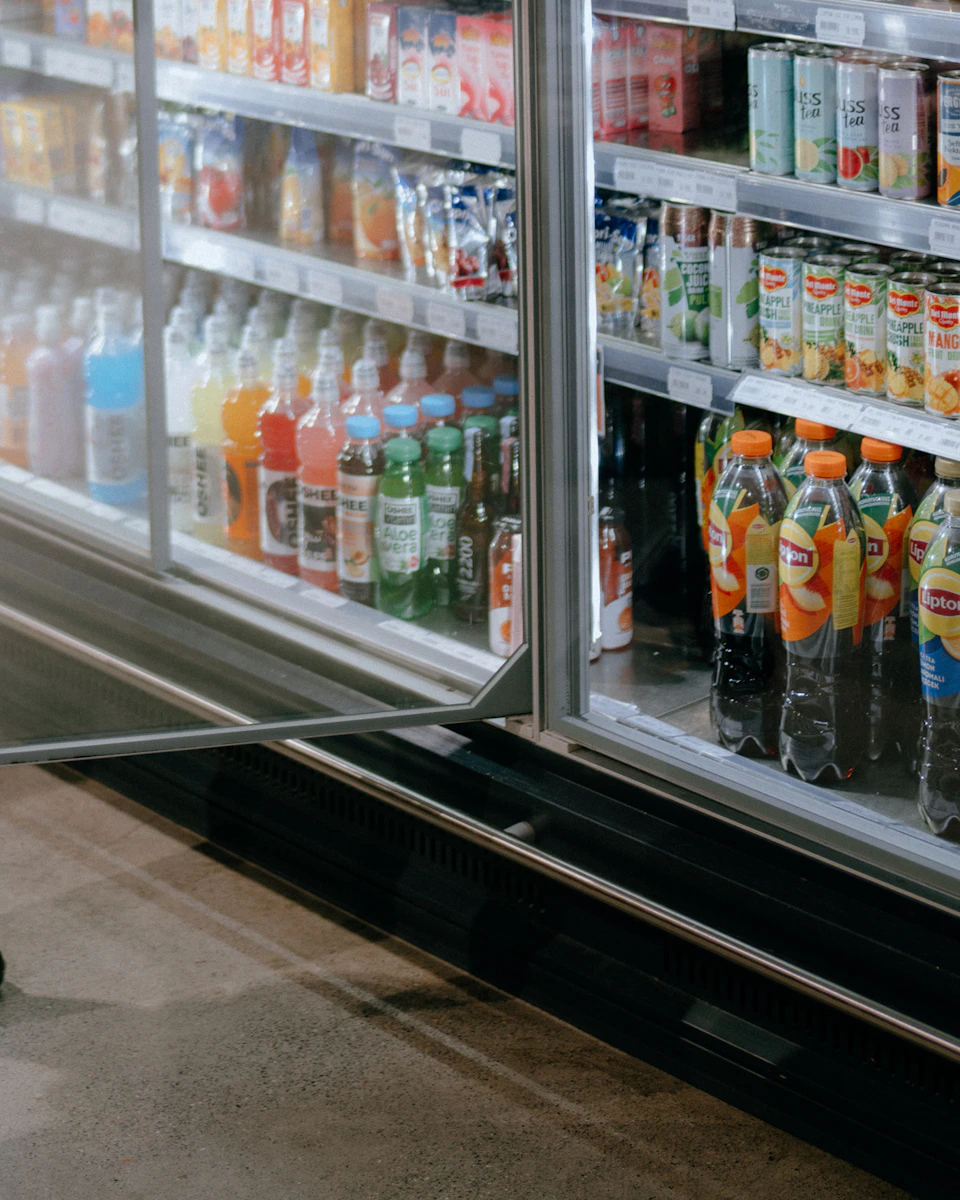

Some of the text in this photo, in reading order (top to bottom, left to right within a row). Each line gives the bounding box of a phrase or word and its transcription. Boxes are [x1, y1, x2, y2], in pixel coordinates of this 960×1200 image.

[801, 105, 821, 120] tea
[843, 113, 865, 128] tea
[815, 281, 837, 291] Monte
[899, 298, 920, 309] Monte
[196, 448, 208, 517] OSHEE
[384, 528, 417, 542] Aloe
[385, 542, 417, 555] vera
[460, 535, 474, 580] 2200
